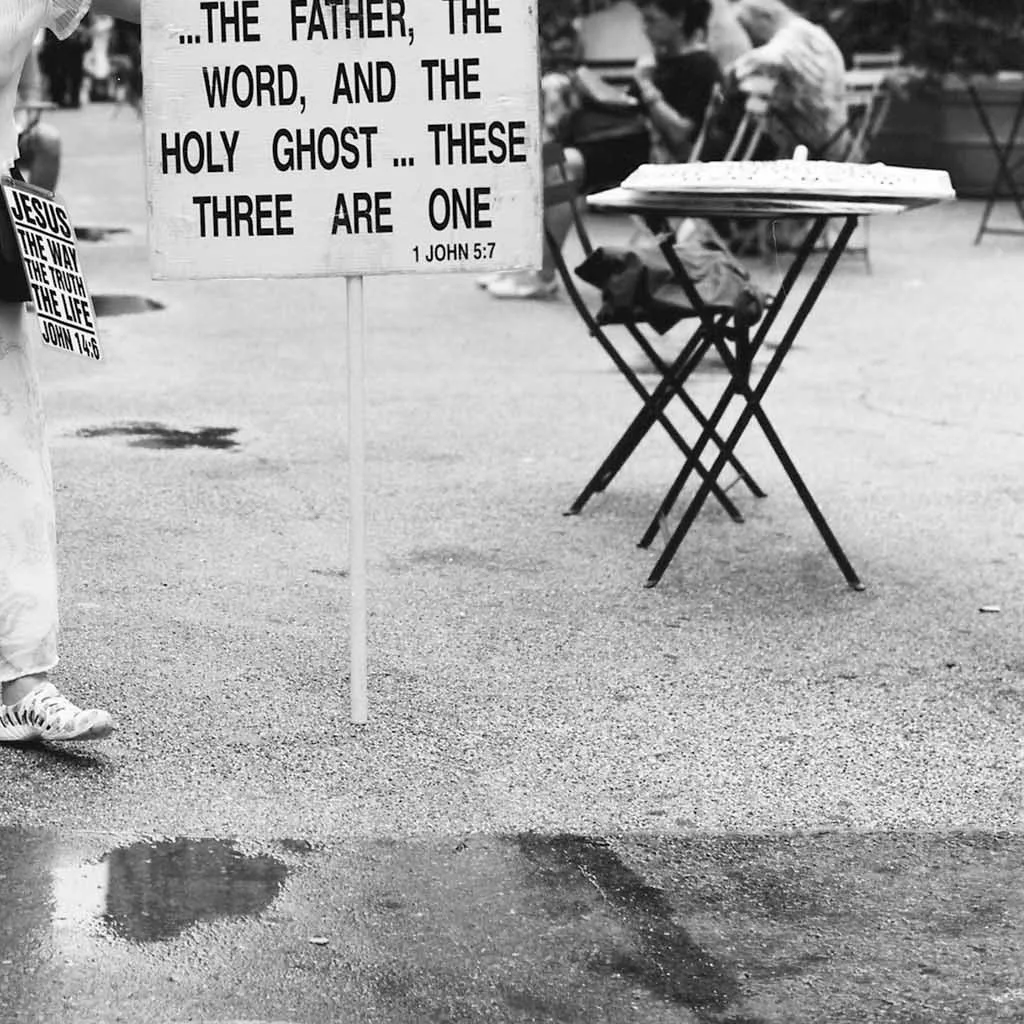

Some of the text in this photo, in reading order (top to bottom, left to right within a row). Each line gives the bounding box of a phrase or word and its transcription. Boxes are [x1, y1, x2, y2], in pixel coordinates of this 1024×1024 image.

[203, 58, 480, 113] WORD, AND THE
[161, 131, 239, 174] HOLY
[273, 127, 377, 171] GHOST
[428, 121, 526, 165] THESE
[11, 190, 72, 239] JESUS
[193, 187, 492, 237] THREE ARE ONE
[17, 228, 78, 273] THE WAY
[413, 243, 495, 262] 1 JOHN 5:7
[24, 257, 86, 298] THE TRUTH
[31, 283, 94, 328] THE LIFE
[42, 320, 100, 360] JOHN 14:6
